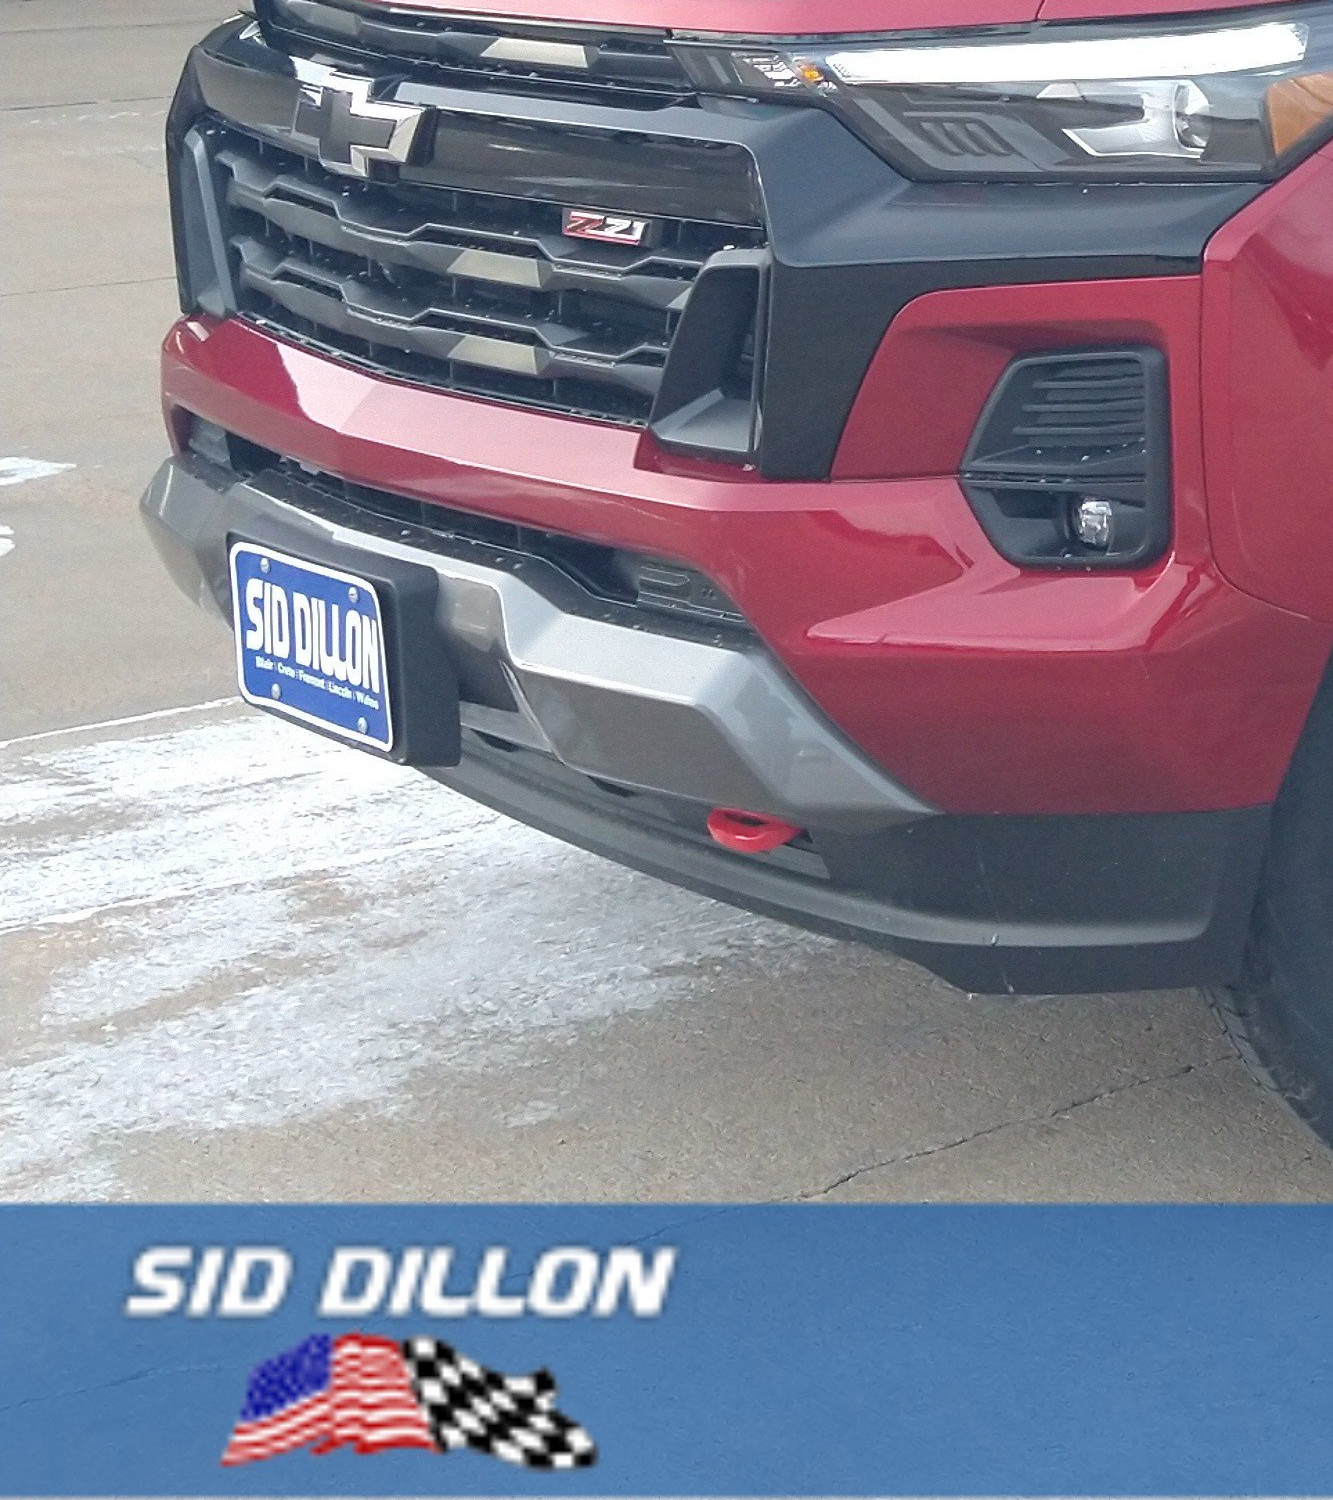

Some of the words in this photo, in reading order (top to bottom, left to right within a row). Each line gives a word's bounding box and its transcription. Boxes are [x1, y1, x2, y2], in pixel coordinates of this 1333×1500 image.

[563, 211, 646, 245] Z71
[245, 578, 290, 659] SID
[292, 591, 380, 694] DILLON
